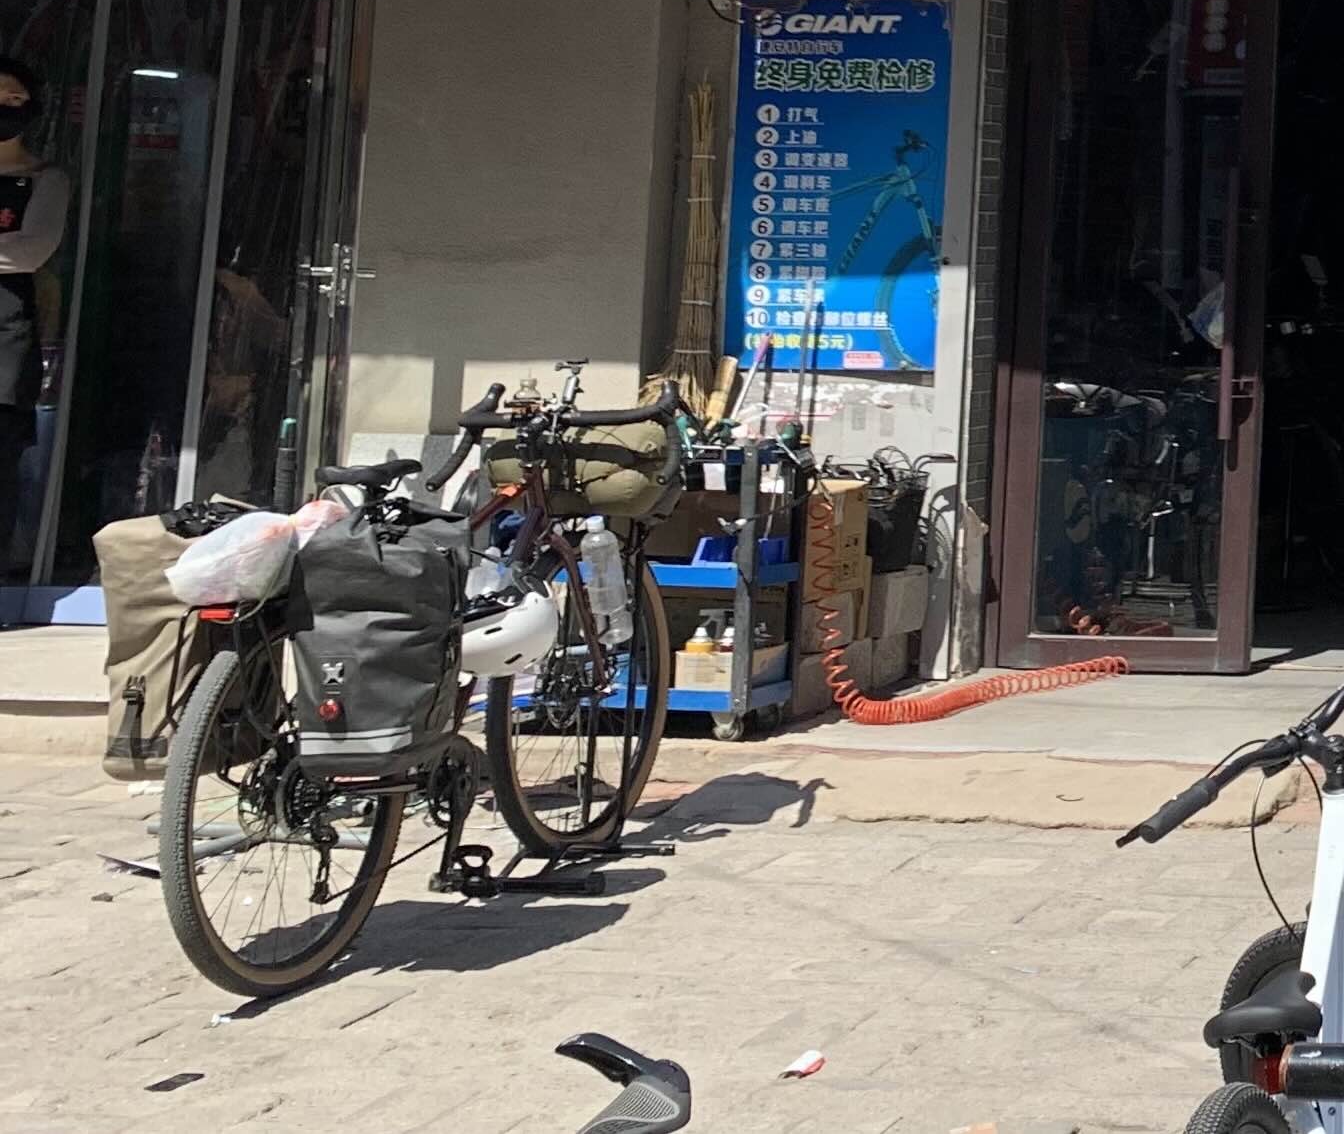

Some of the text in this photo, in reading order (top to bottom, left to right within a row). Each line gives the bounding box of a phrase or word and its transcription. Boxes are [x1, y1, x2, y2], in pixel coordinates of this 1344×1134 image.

[784, 15, 902, 34] GIANT
[755, 58, 936, 92] 终身免费检修
[786, 107, 819, 123] 打气
